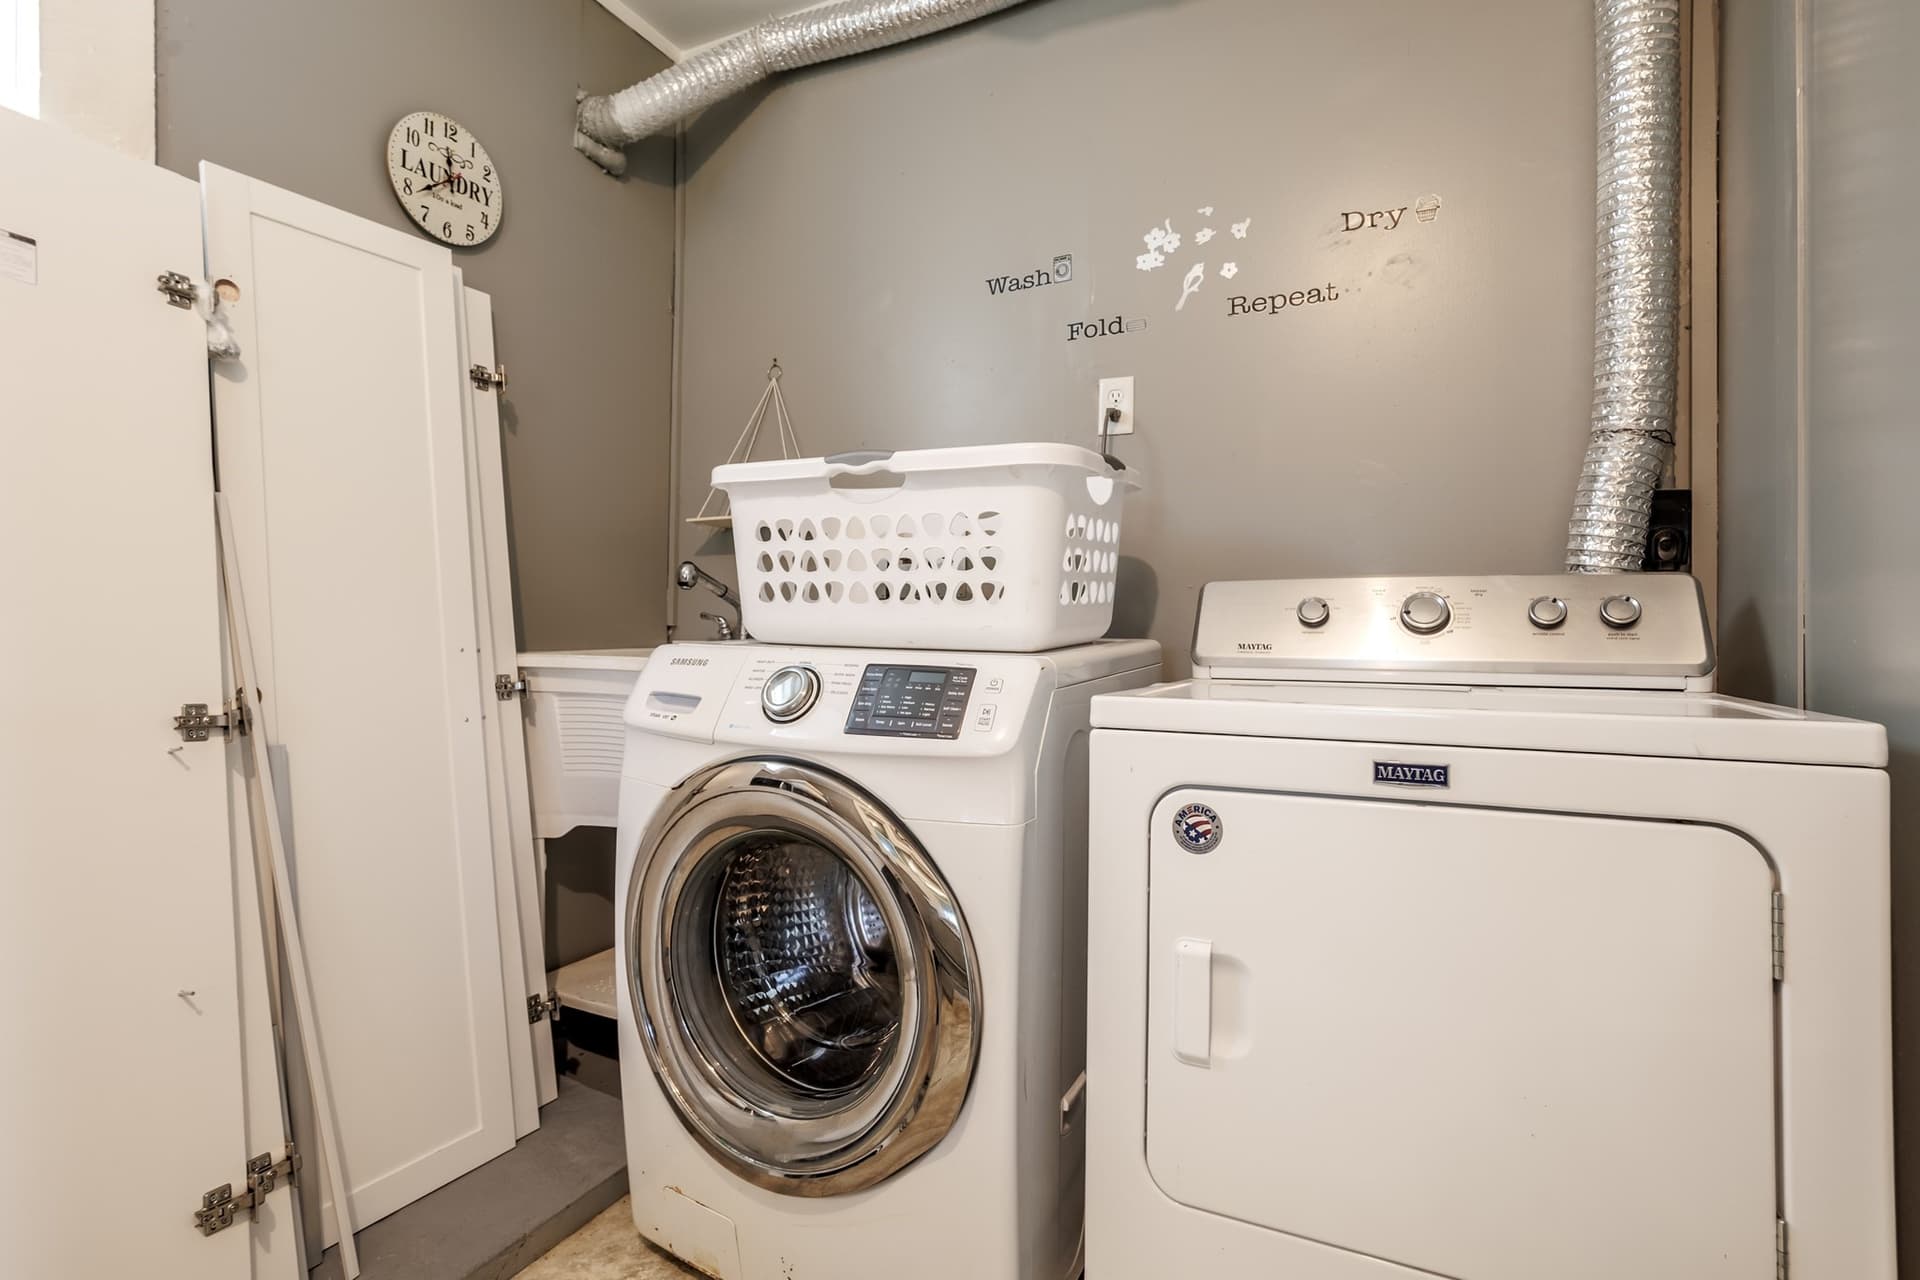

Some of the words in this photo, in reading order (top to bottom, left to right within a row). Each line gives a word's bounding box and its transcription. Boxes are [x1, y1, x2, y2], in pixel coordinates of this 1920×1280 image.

[406, 126, 420, 147] 10
[424, 118, 434, 137] 11
[444, 122, 458, 142] 12
[401, 148, 493, 207] LAUNDRY
[483, 165, 491, 182] 2
[403, 178, 413, 196] 8
[420, 205, 430, 222] 7
[480, 211, 489, 229] 4
[1341, 206, 1407, 233] Dry
[443, 222, 452, 238] 6
[466, 224, 474, 241] 5
[986, 269, 1052, 296] Wash
[1227, 281, 1340, 317] Repeat
[1066, 316, 1125, 342] Fold
[1237, 643, 1273, 651] MAYTAG
[670, 657, 709, 667] SAMSUNG
[1376, 765, 1446, 784] MAYTAG
[1175, 805, 1218, 828] AMERICA
